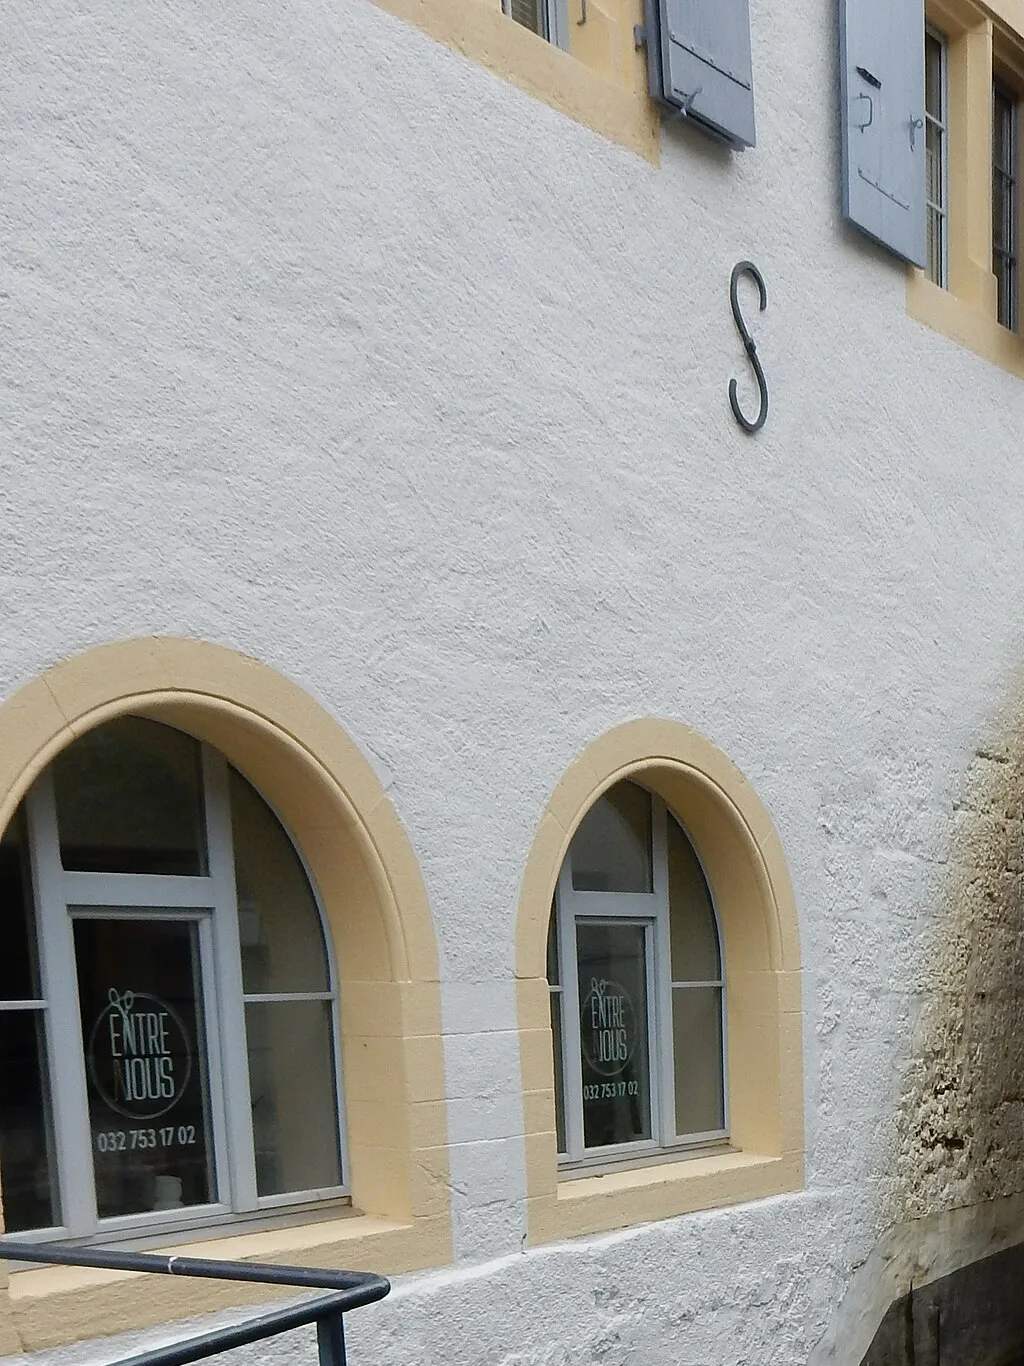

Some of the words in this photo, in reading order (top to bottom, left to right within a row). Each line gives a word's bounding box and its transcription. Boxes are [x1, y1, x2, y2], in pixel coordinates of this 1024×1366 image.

[591, 995, 626, 1029] ENTRE
[109, 1012, 171, 1057] ENTRE
[113, 1056, 175, 1102] NOUS
[584, 1084, 599, 1101] 032
[601, 1082, 616, 1098] 753
[618, 1081, 626, 1097] 17
[628, 1080, 638, 1096] 02
[97, 1131, 126, 1153] 032
[130, 1128, 156, 1149] 753
[159, 1126, 174, 1147] 17
[178, 1124, 196, 1145] 02
